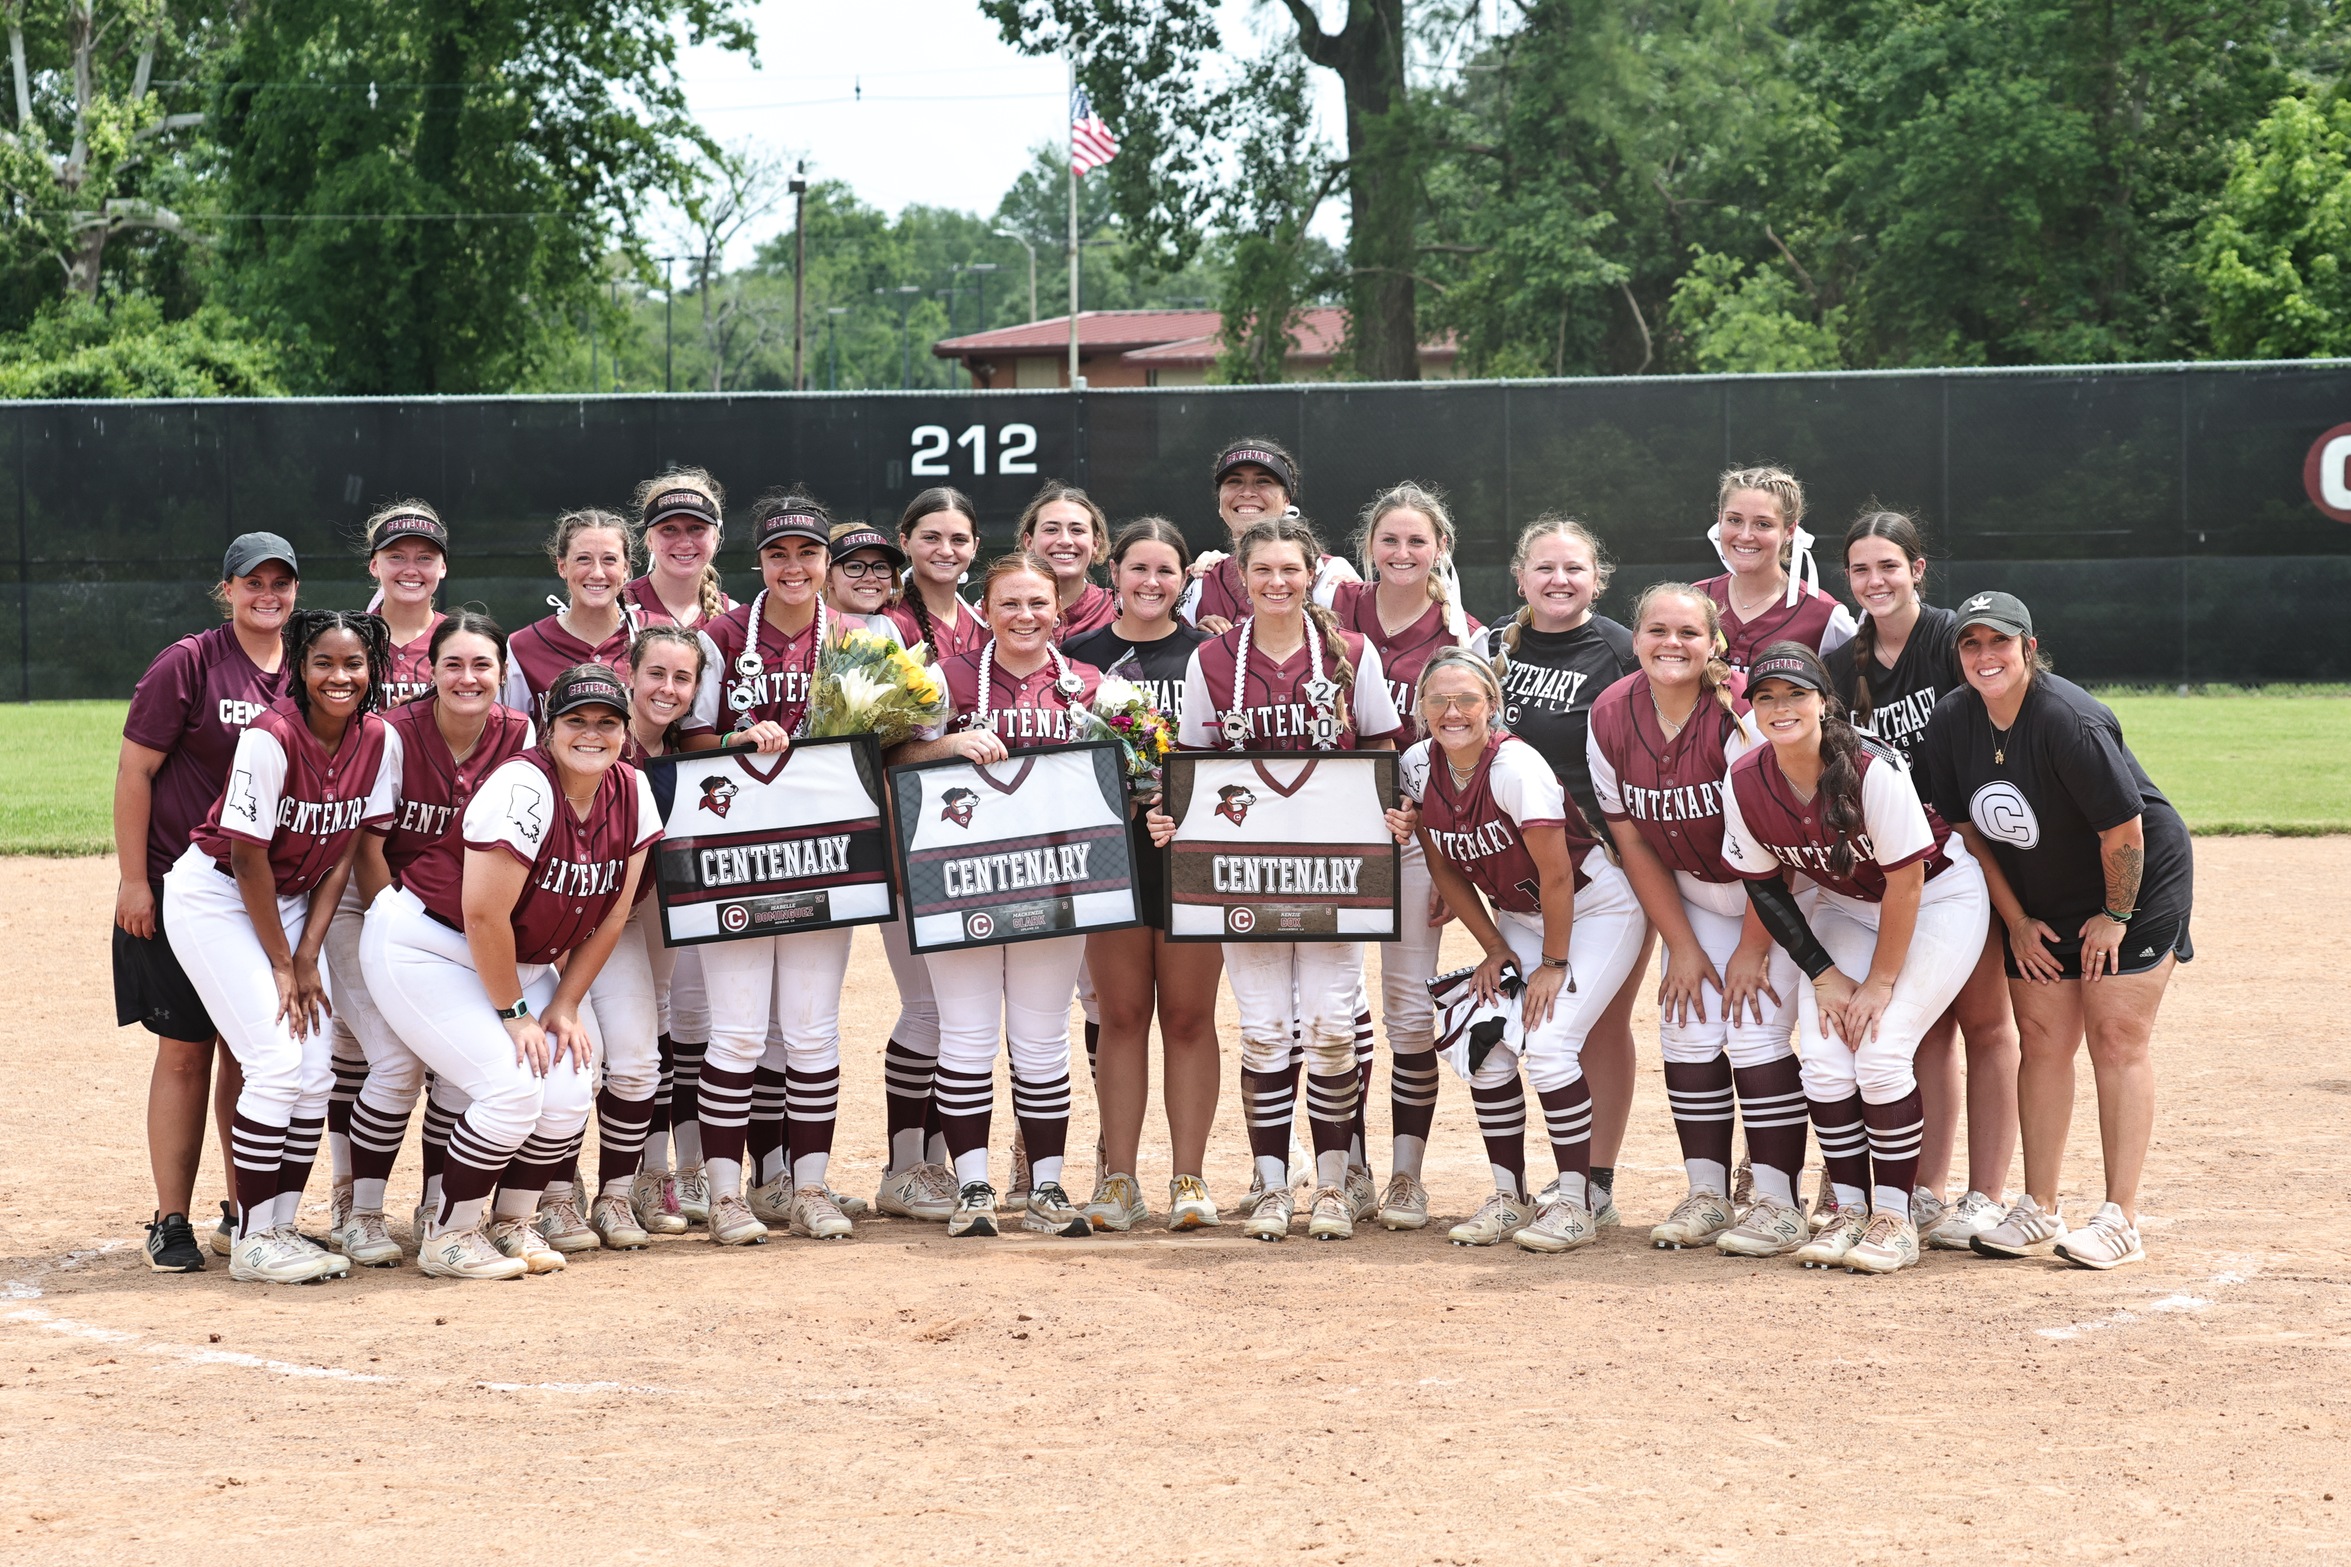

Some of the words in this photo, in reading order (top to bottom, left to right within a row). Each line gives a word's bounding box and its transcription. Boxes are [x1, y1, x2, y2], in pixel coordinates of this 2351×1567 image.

[911, 423, 1037, 476] 212
[1226, 449, 1275, 465] CENTENARY
[386, 518, 436, 533] CENTENARY
[765, 514, 815, 530] CENTENARY
[1754, 658, 1805, 677] CENTENARY
[568, 681, 619, 698] CENTENARY
[1315, 682, 1329, 701] 2
[1981, 793, 2030, 843] C
[699, 833, 851, 888] CENTENARY
[942, 841, 1092, 899] CENTENARY
[1211, 854, 1363, 894] CENTENARY
[754, 906, 814, 924] DOMINGUEZ
[1012, 915, 1047, 929] CLARK
[1280, 917, 1302, 928] COX
